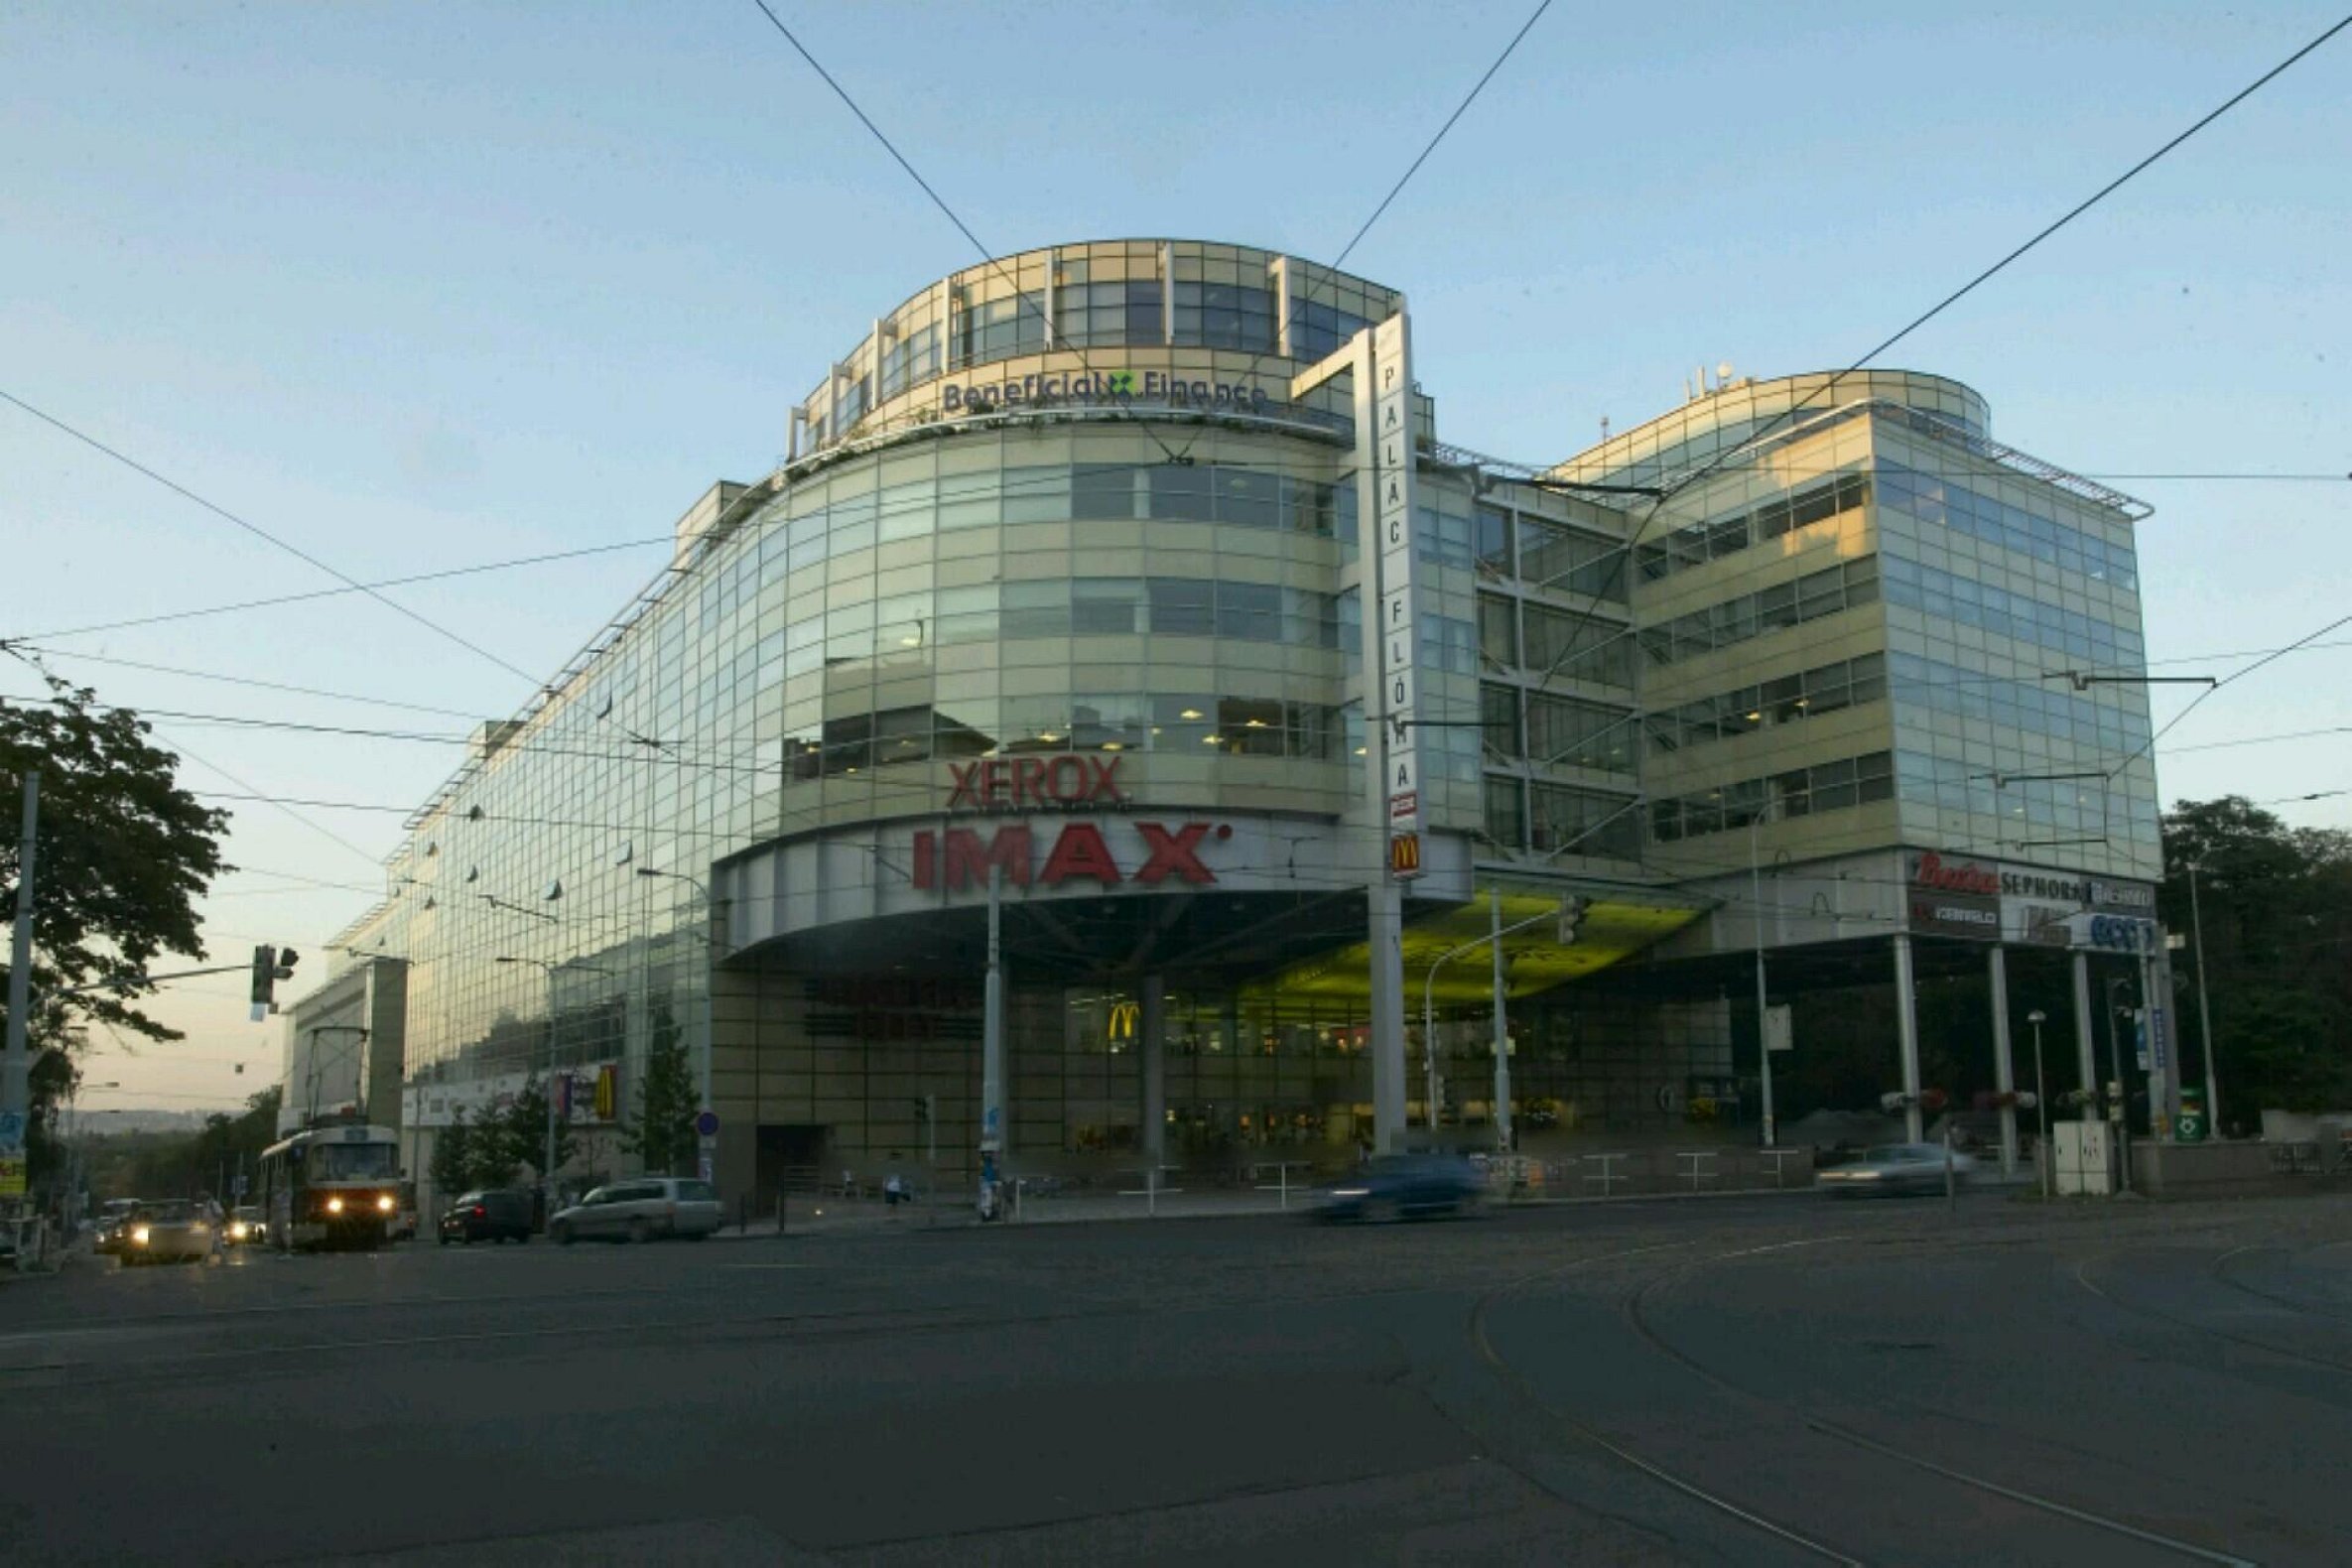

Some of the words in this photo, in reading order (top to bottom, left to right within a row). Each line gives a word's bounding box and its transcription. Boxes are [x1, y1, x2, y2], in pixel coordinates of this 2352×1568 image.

[945, 371, 1100, 412] Beneficial
[1144, 370, 1268, 410] Finance
[947, 755, 1122, 808] XEROX
[913, 822, 1219, 889] IMAX
[2001, 871, 2084, 901] SEPHORA
